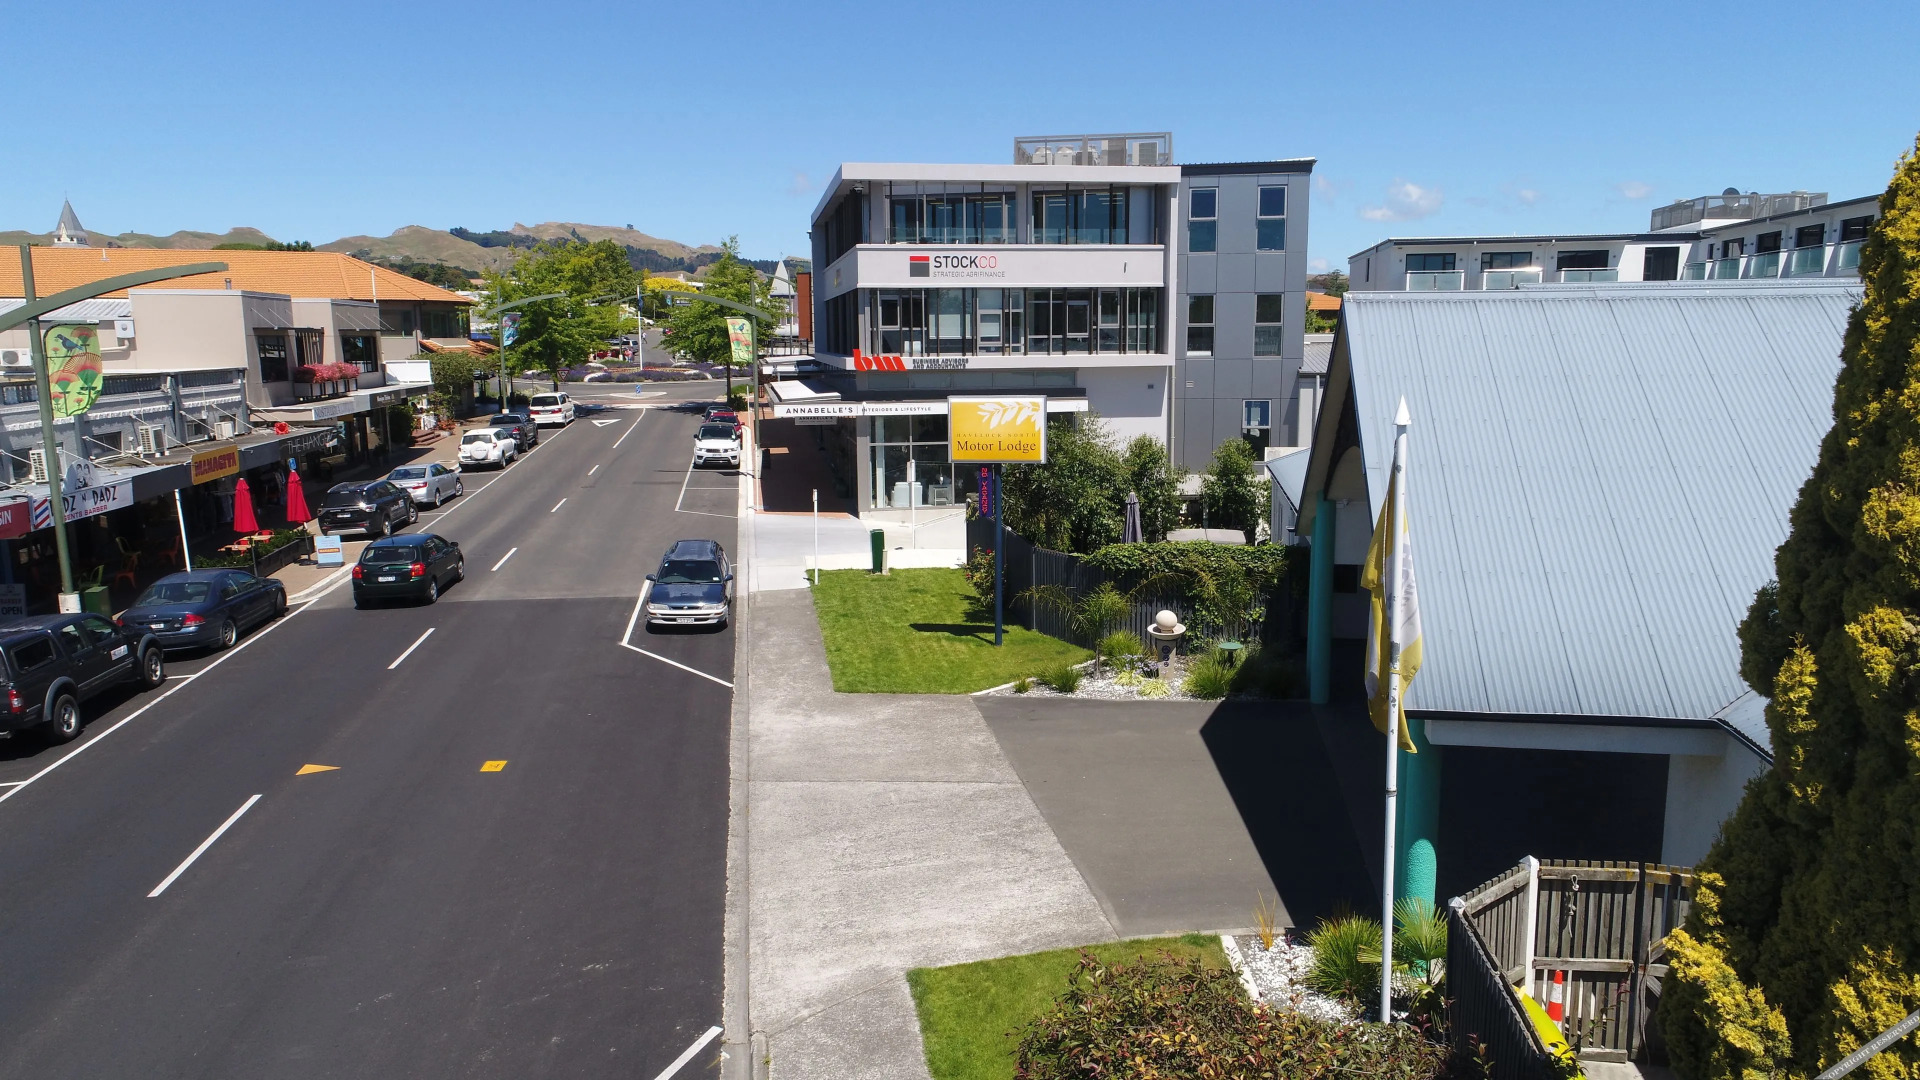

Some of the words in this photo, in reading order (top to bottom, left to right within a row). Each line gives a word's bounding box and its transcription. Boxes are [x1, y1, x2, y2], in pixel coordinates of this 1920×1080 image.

[934, 255, 997, 269] STOCKCO
[957, 440, 994, 452] Motor
[998, 440, 1037, 454] Lodge
[92, 486, 118, 506] DADZ
[84, 505, 108, 516] BARBER
